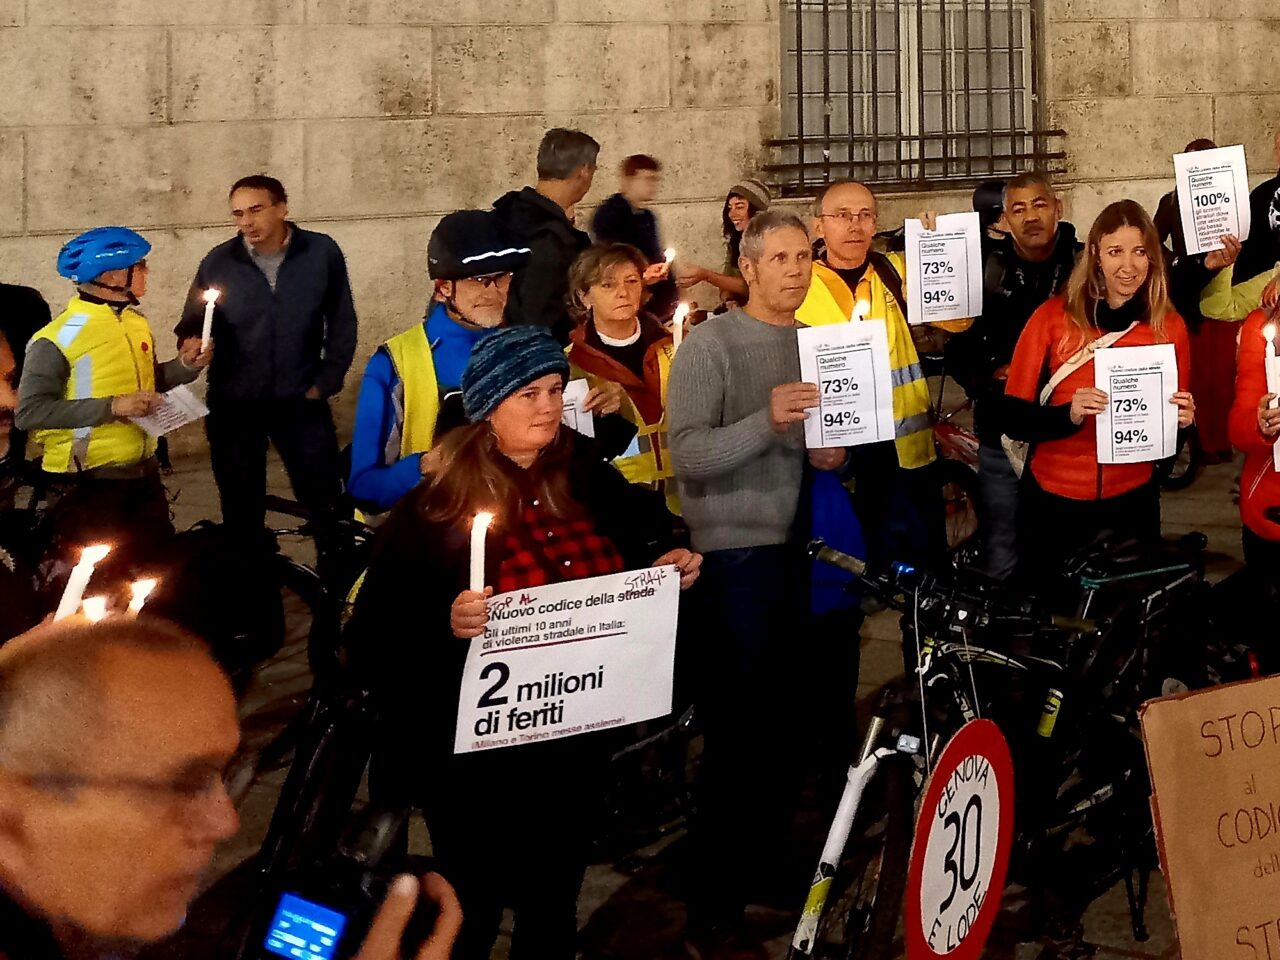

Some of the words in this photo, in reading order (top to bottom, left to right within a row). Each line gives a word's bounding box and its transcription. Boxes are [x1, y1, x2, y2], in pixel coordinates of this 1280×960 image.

[1194, 192, 1230, 207] 100%
[923, 261, 953, 274] 73%
[924, 290, 954, 303] 94%
[822, 377, 858, 394] 73%
[1114, 398, 1147, 412] 73%
[824, 411, 860, 427] 94%
[1115, 429, 1147, 444] 94%
[625, 568, 667, 591] STRAGE
[491, 602, 535, 621] Nuovo
[539, 600, 582, 614] codice
[586, 595, 614, 607] della
[520, 594, 537, 605] AL
[483, 639, 492, 650] di
[496, 633, 540, 647] violenza
[543, 626, 584, 641] stradale
[587, 622, 596, 633] in
[599, 620, 625, 631] Italia:
[484, 628, 499, 639] Gli
[502, 623, 531, 637] ultimi
[535, 622, 546, 631] 10
[549, 617, 571, 629] anni
[477, 662, 510, 709] 2
[517, 666, 603, 702] milioni
[474, 712, 499, 736] di
[507, 700, 564, 732] feriti
[938, 754, 990, 819] GENOVA
[1244, 774, 1256, 795] al
[940, 793, 982, 915] 30
[928, 918, 941, 950] E
[946, 881, 987, 952] LODE
